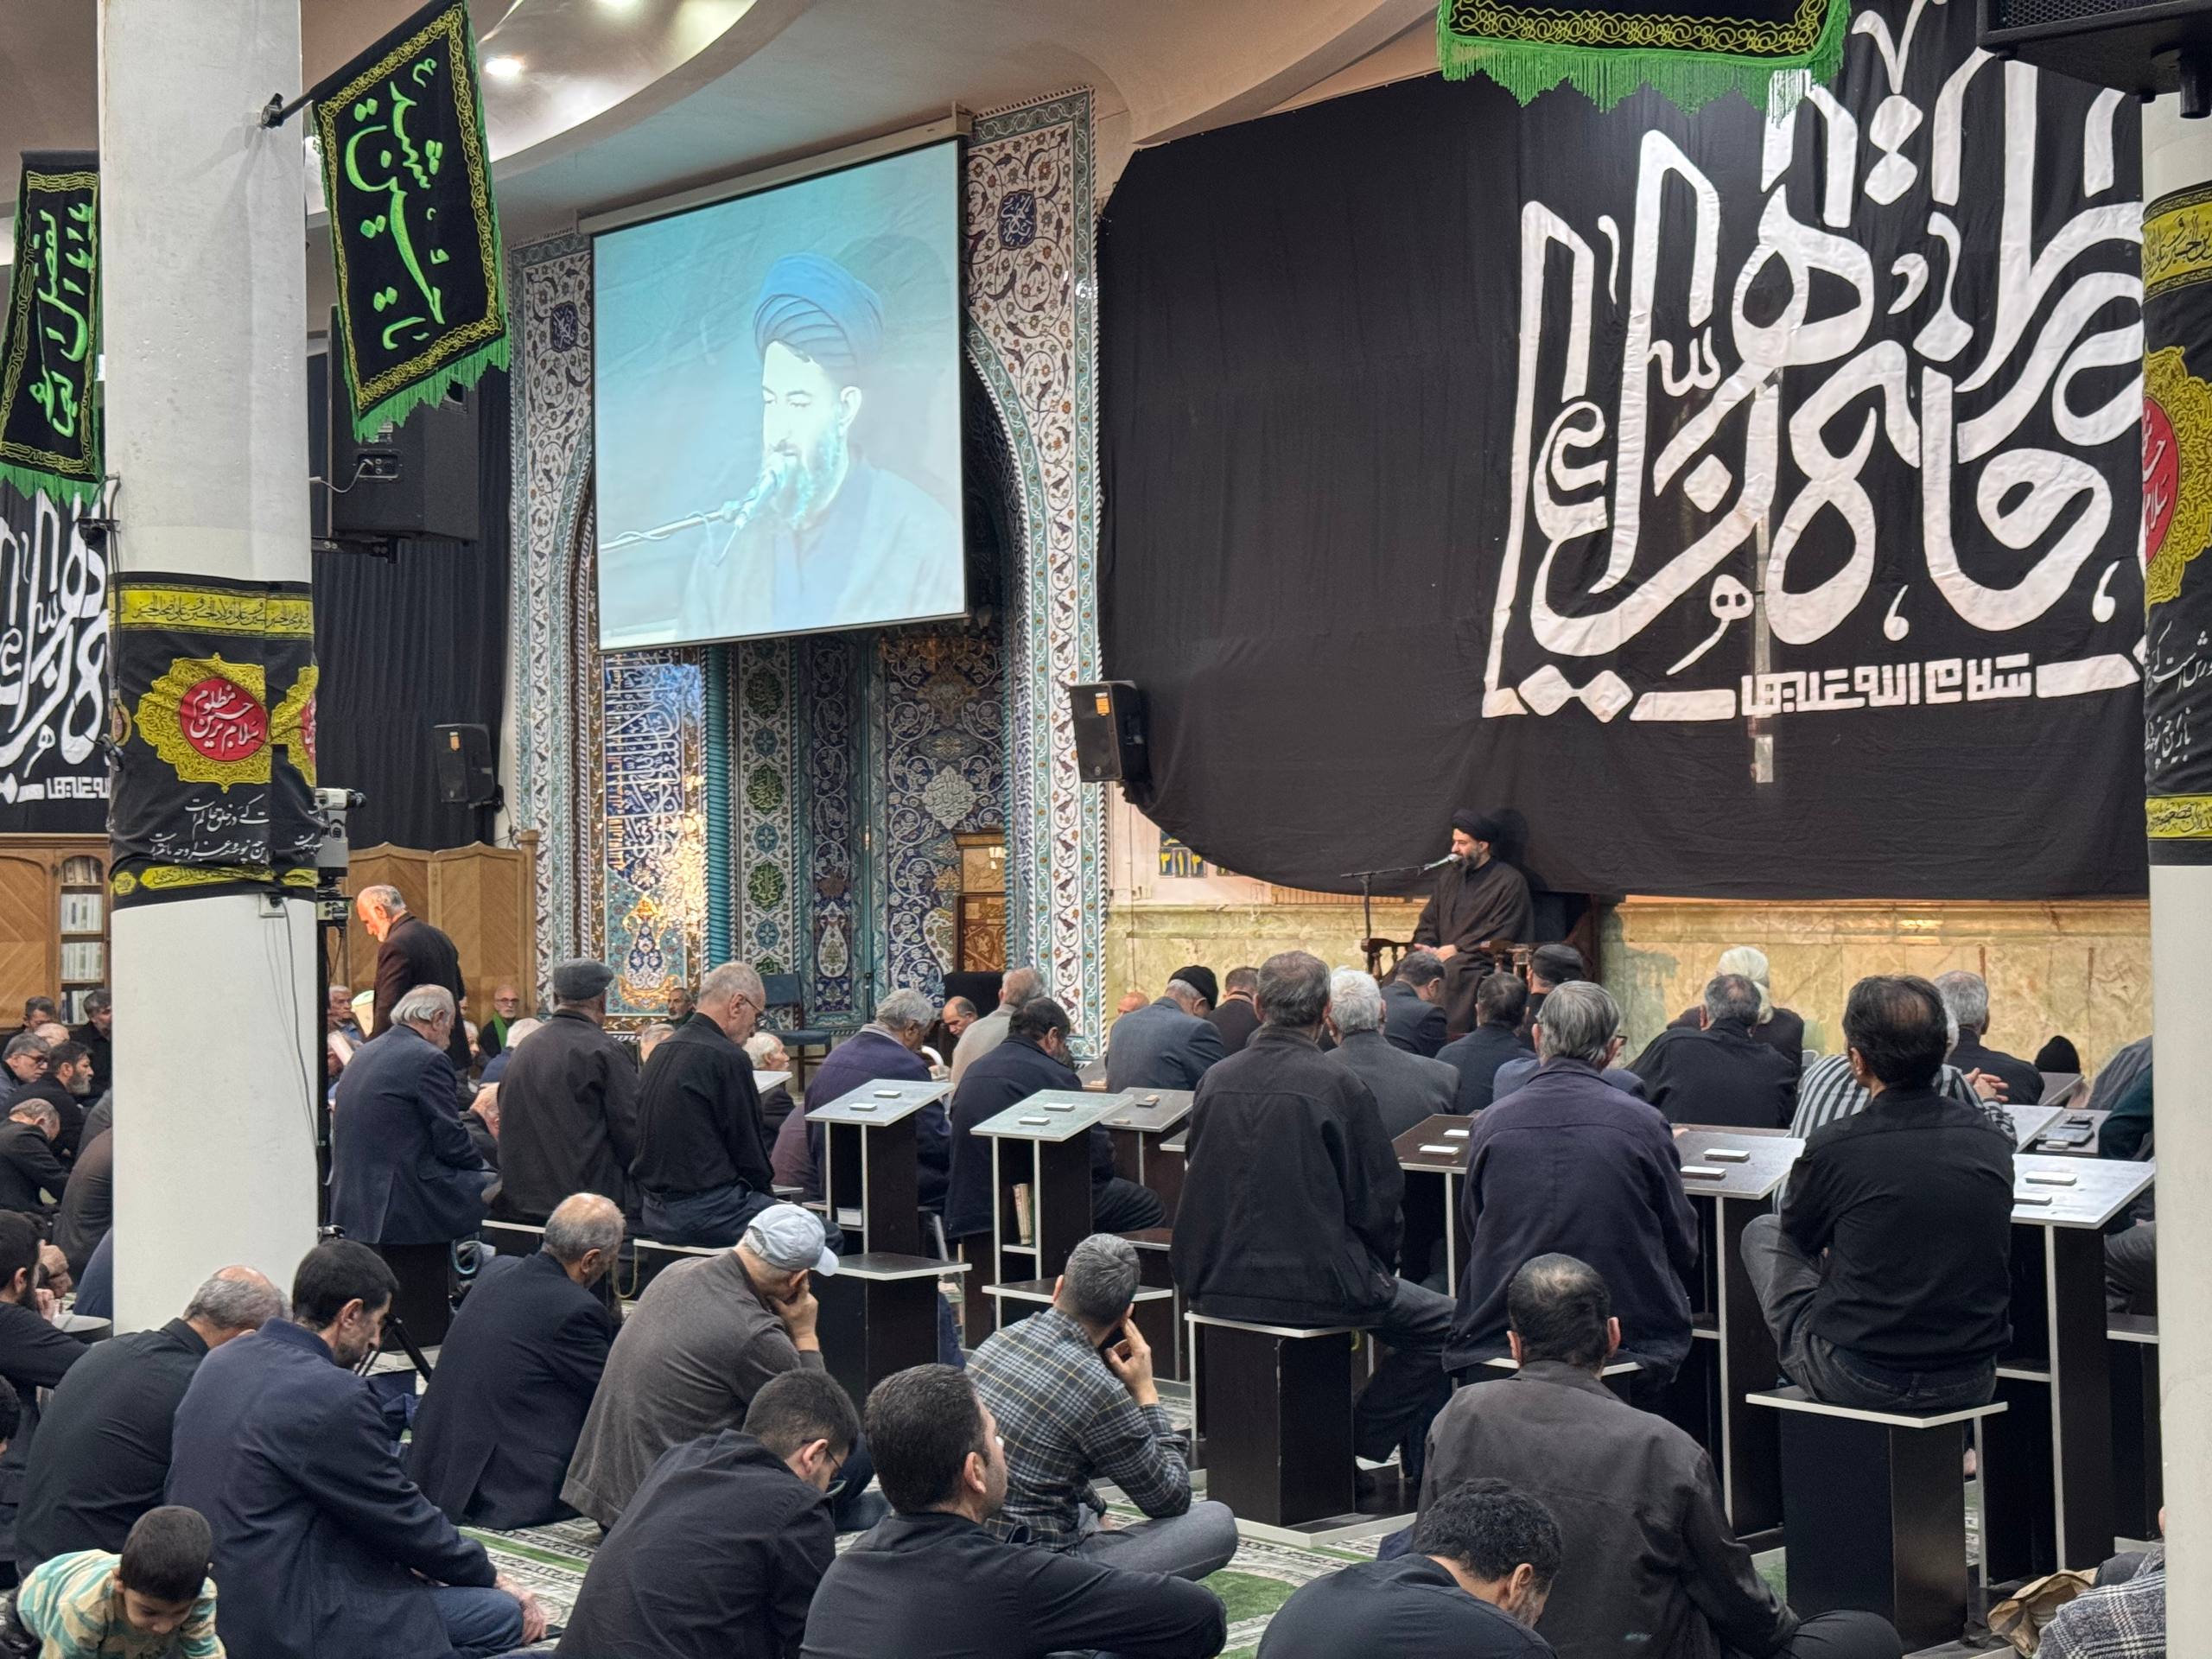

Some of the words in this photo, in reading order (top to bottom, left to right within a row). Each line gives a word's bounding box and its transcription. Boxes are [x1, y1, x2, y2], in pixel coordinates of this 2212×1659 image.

[1741, 669, 1866, 718] علیها
[1855, 663, 1920, 707] الله
[1925, 653, 2031, 705] سلام
[189, 702, 254, 741] حسین
[193, 684, 237, 721] مظلوم
[221, 721, 259, 757] سلام
